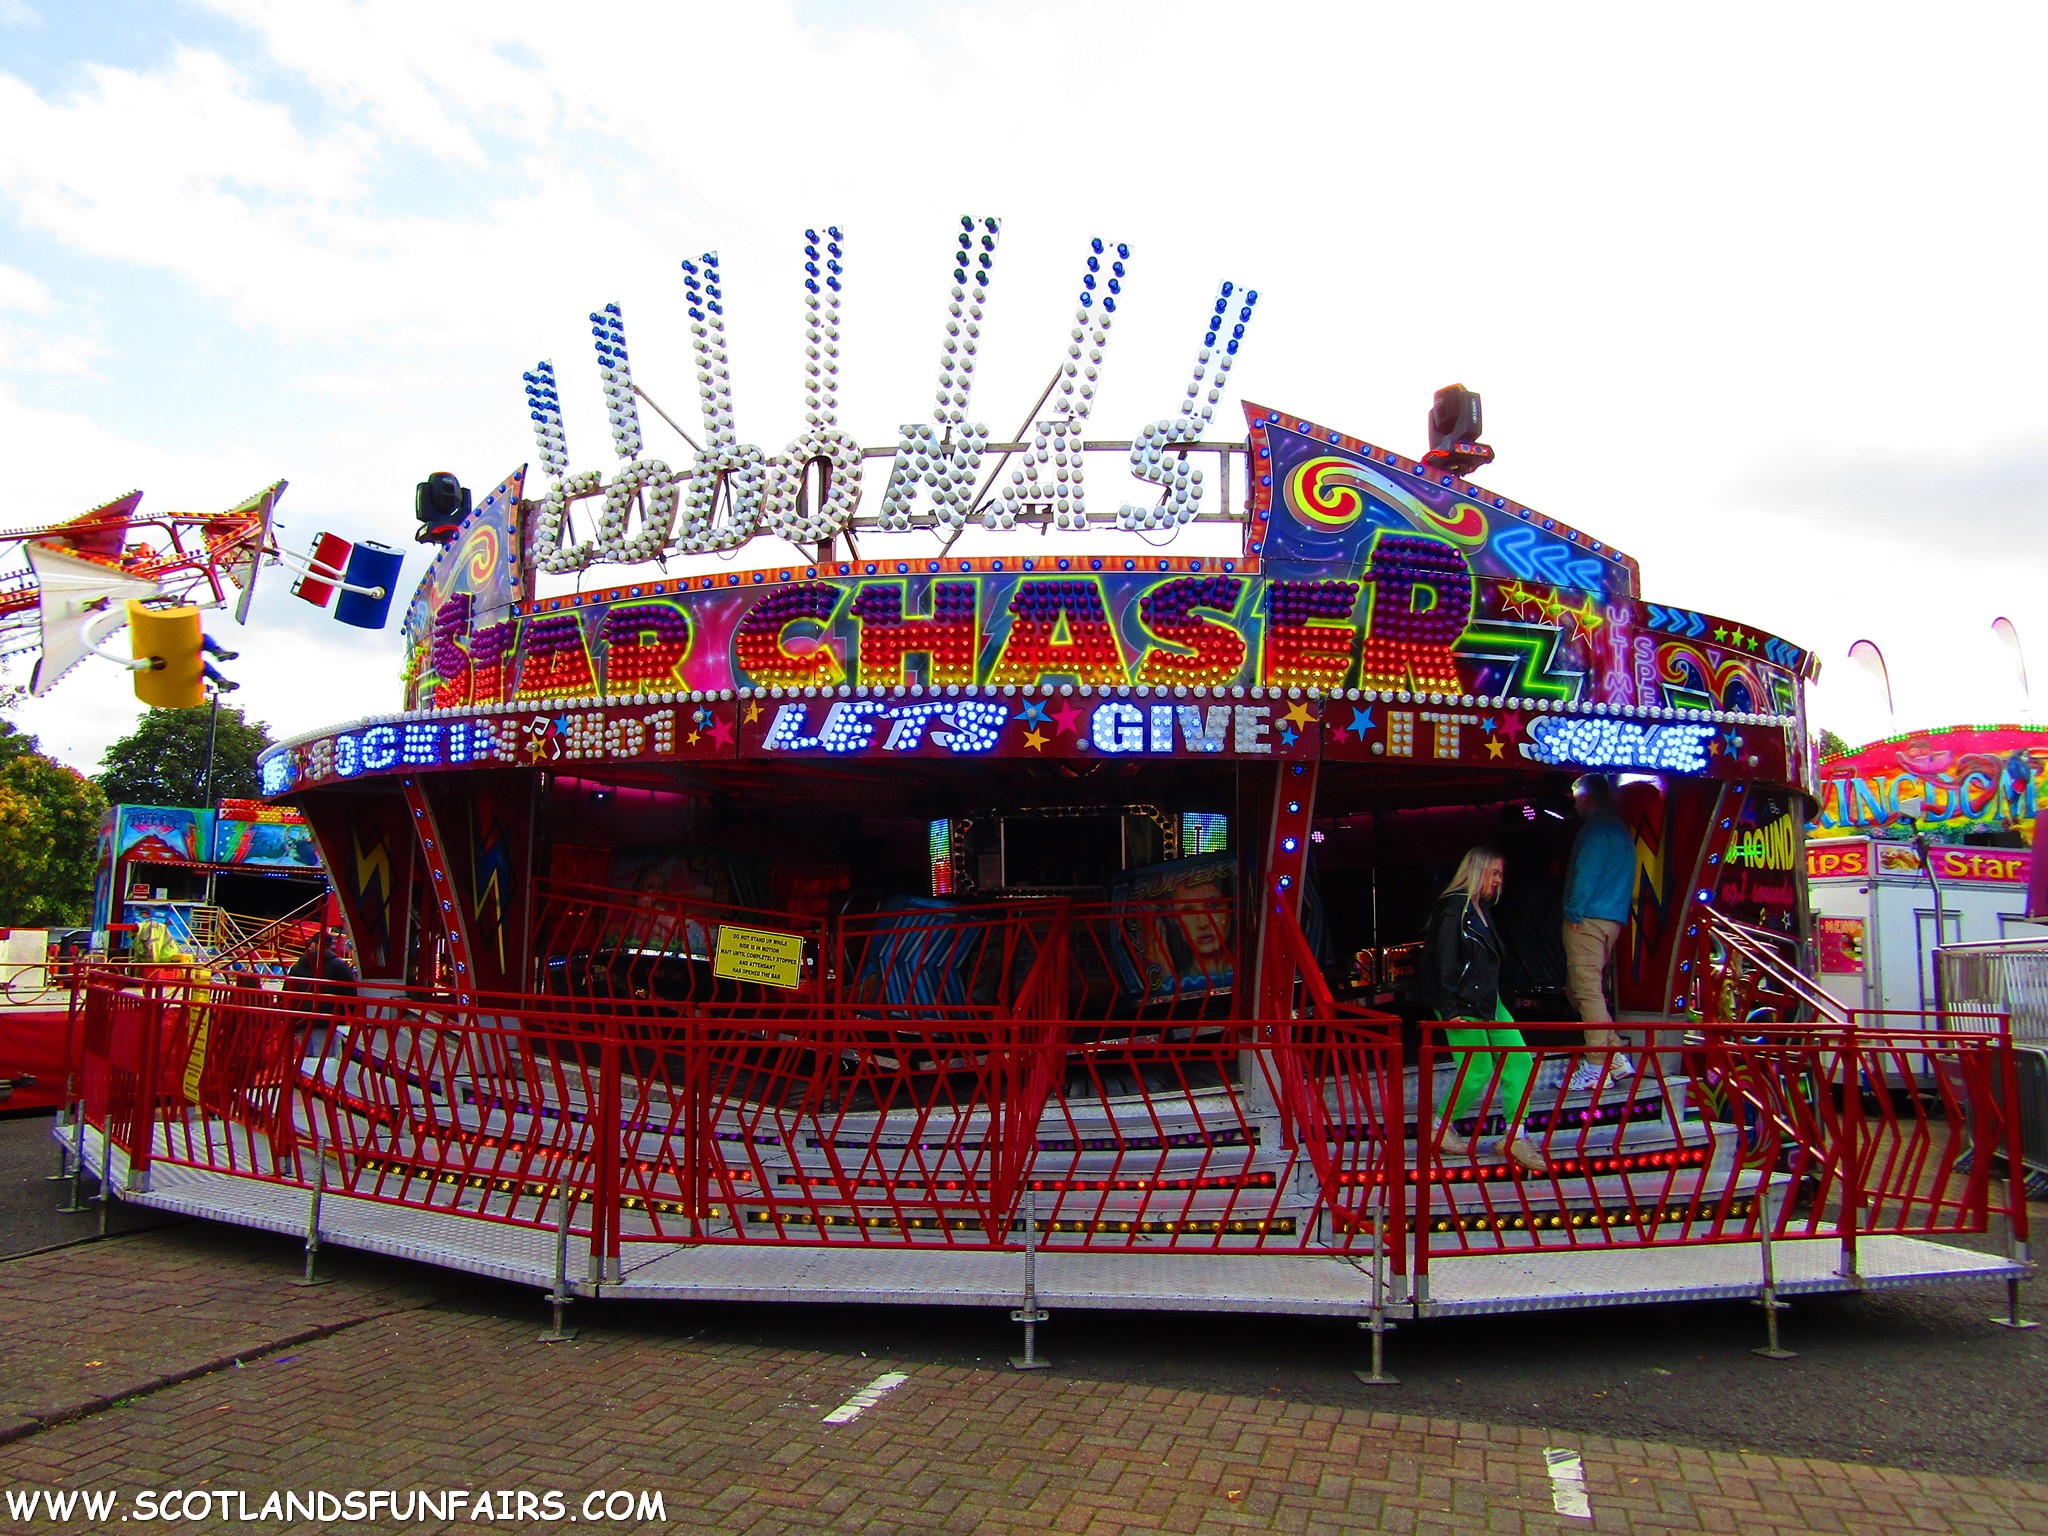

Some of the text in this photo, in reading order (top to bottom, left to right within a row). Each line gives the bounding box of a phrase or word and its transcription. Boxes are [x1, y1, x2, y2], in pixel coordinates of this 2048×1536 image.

[532, 418, 1204, 574] CODONAS
[432, 528, 1475, 709] STAR CHASER
[565, 709, 676, 759] HOT
[762, 700, 1271, 754] LETS GIVE
[1387, 710, 1479, 760] IT
[1743, 813, 1795, 870] ROUND
[1807, 850, 1863, 875] ips
[1943, 851, 2023, 879] Star
[1824, 920, 1858, 933] MENU
[750, 935, 765, 943] STAND
[773, 939, 788, 947] WHILE
[742, 968, 761, 976] OPENED
[746, 952, 775, 962] COMPLETELY
[776, 957, 797, 965] STOPPED
[749, 961, 776, 971] ATTENDANT
